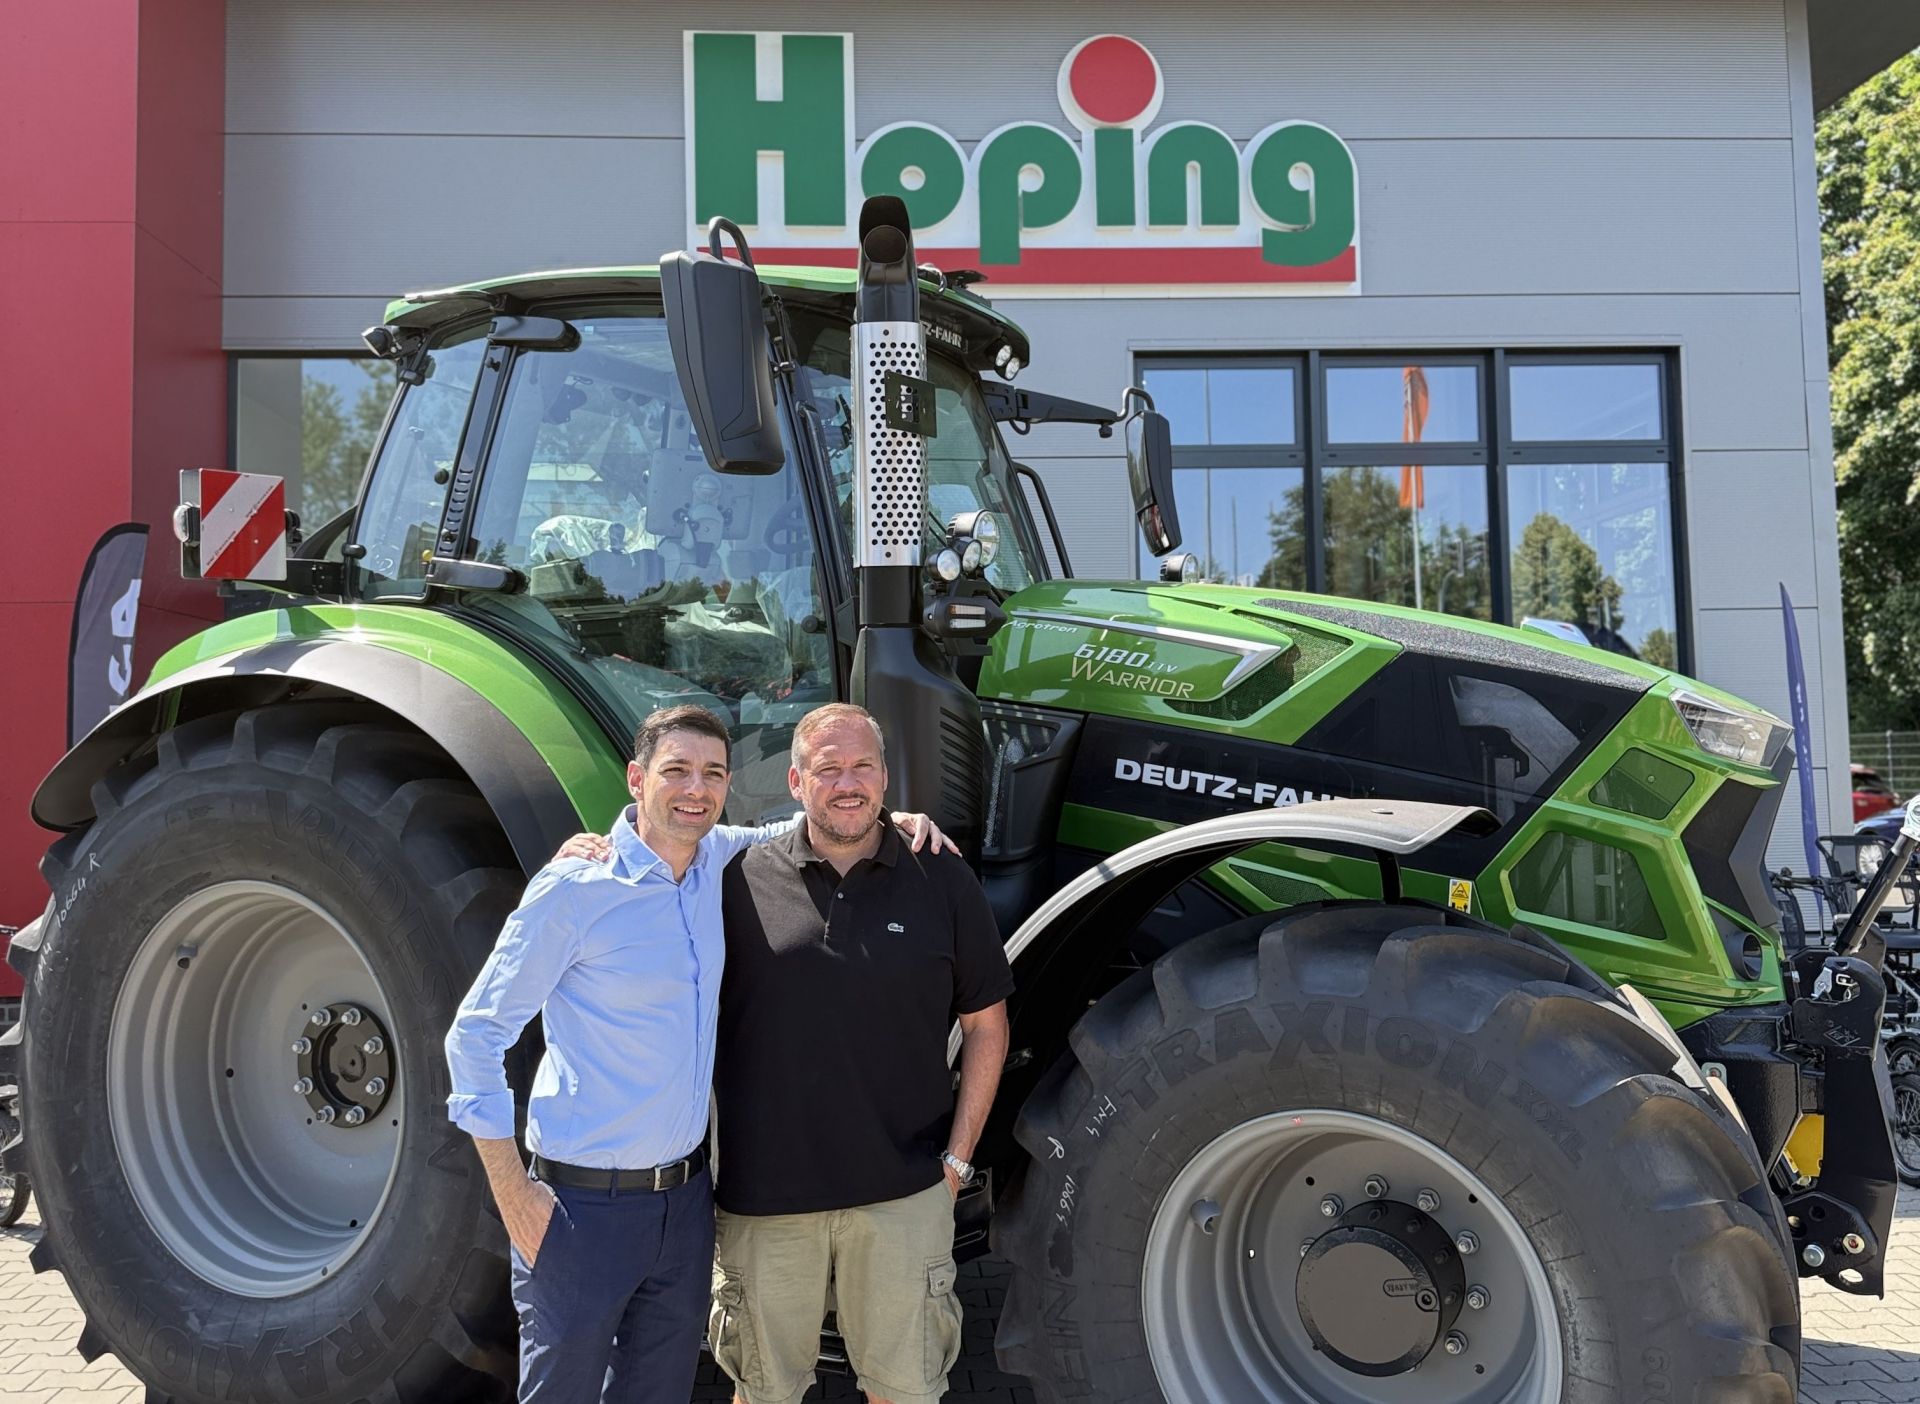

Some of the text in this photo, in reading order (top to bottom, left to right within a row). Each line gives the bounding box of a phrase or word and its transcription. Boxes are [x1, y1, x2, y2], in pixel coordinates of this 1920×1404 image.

[693, 32, 1355, 267] Hoping
[1001, 619, 1078, 634] Agrotron
[1074, 643, 1150, 668] 6180
[1071, 656, 1195, 698] WARRIOR
[1114, 757, 1349, 808] DEUTZ-FA
[88, 852, 101, 872] R
[1113, 1000, 1508, 1111] TRAXION
